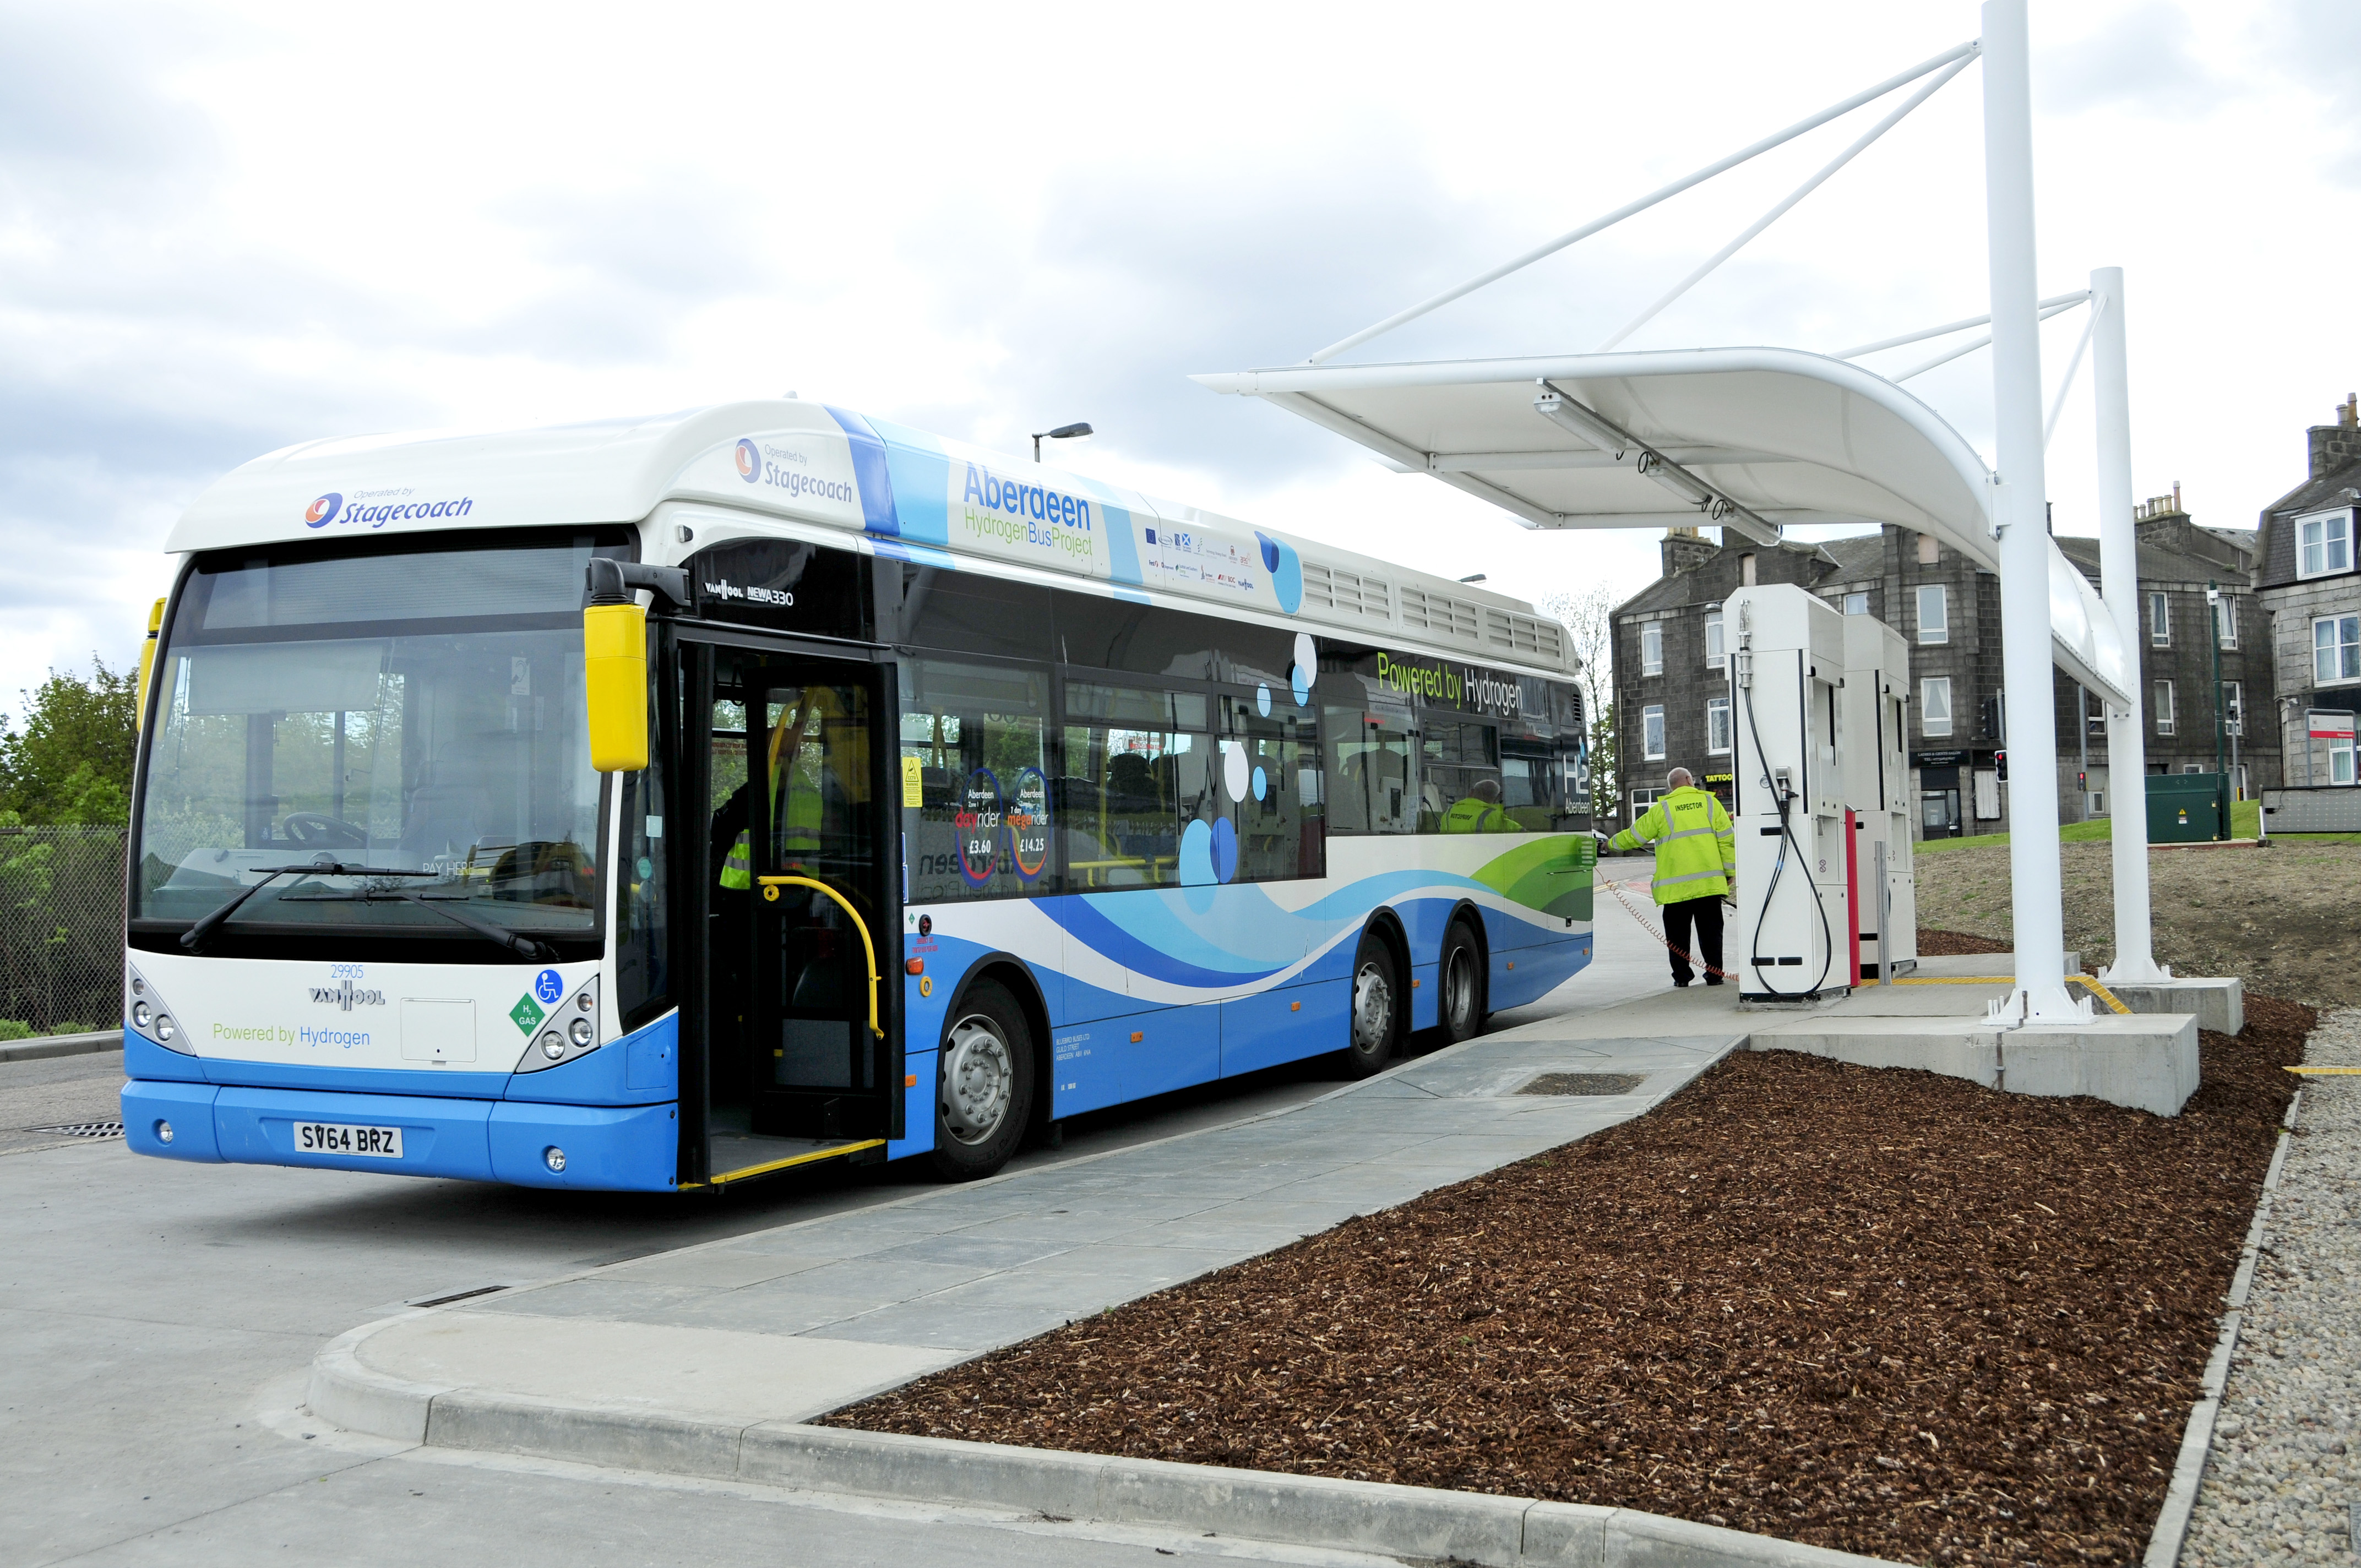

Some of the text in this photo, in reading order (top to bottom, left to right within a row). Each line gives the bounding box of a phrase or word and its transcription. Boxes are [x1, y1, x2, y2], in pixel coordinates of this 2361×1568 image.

[765, 444, 807, 466] Operated by
[765, 461, 852, 503] Stagecoach
[354, 487, 416, 500] Operated by
[964, 461, 1091, 531] Aberdeen
[339, 496, 473, 529] Stagecoach
[1378, 652, 1523, 716] Powered by Hydrogen
[1563, 754, 1589, 794] H2
[967, 788, 994, 799] Aberdeen
[1020, 788, 1045, 798] Aberdeen
[1565, 797, 1591, 814] Aberdeen
[1674, 802, 1703, 812] INSPECTOR
[955, 806, 1000, 834] dayrider
[1007, 809, 1049, 830] megarider
[969, 840, 991, 853] £3.60
[1020, 838, 1045, 852] £14.25
[423, 861, 475, 876] PAY HERE
[331, 964, 364, 979] 29905
[519, 1016, 536, 1025] GAS
[214, 1023, 370, 1049] Powered by Hydrogen
[1056, 1036, 1073, 1046] BLUEBIRD
[1073, 1035, 1083, 1043] BUSES
[1056, 1043, 1079, 1053] GUILD STREET
[1056, 1052, 1074, 1061] ABERDEEN
[302, 1125, 394, 1153] SV64 BRZ
